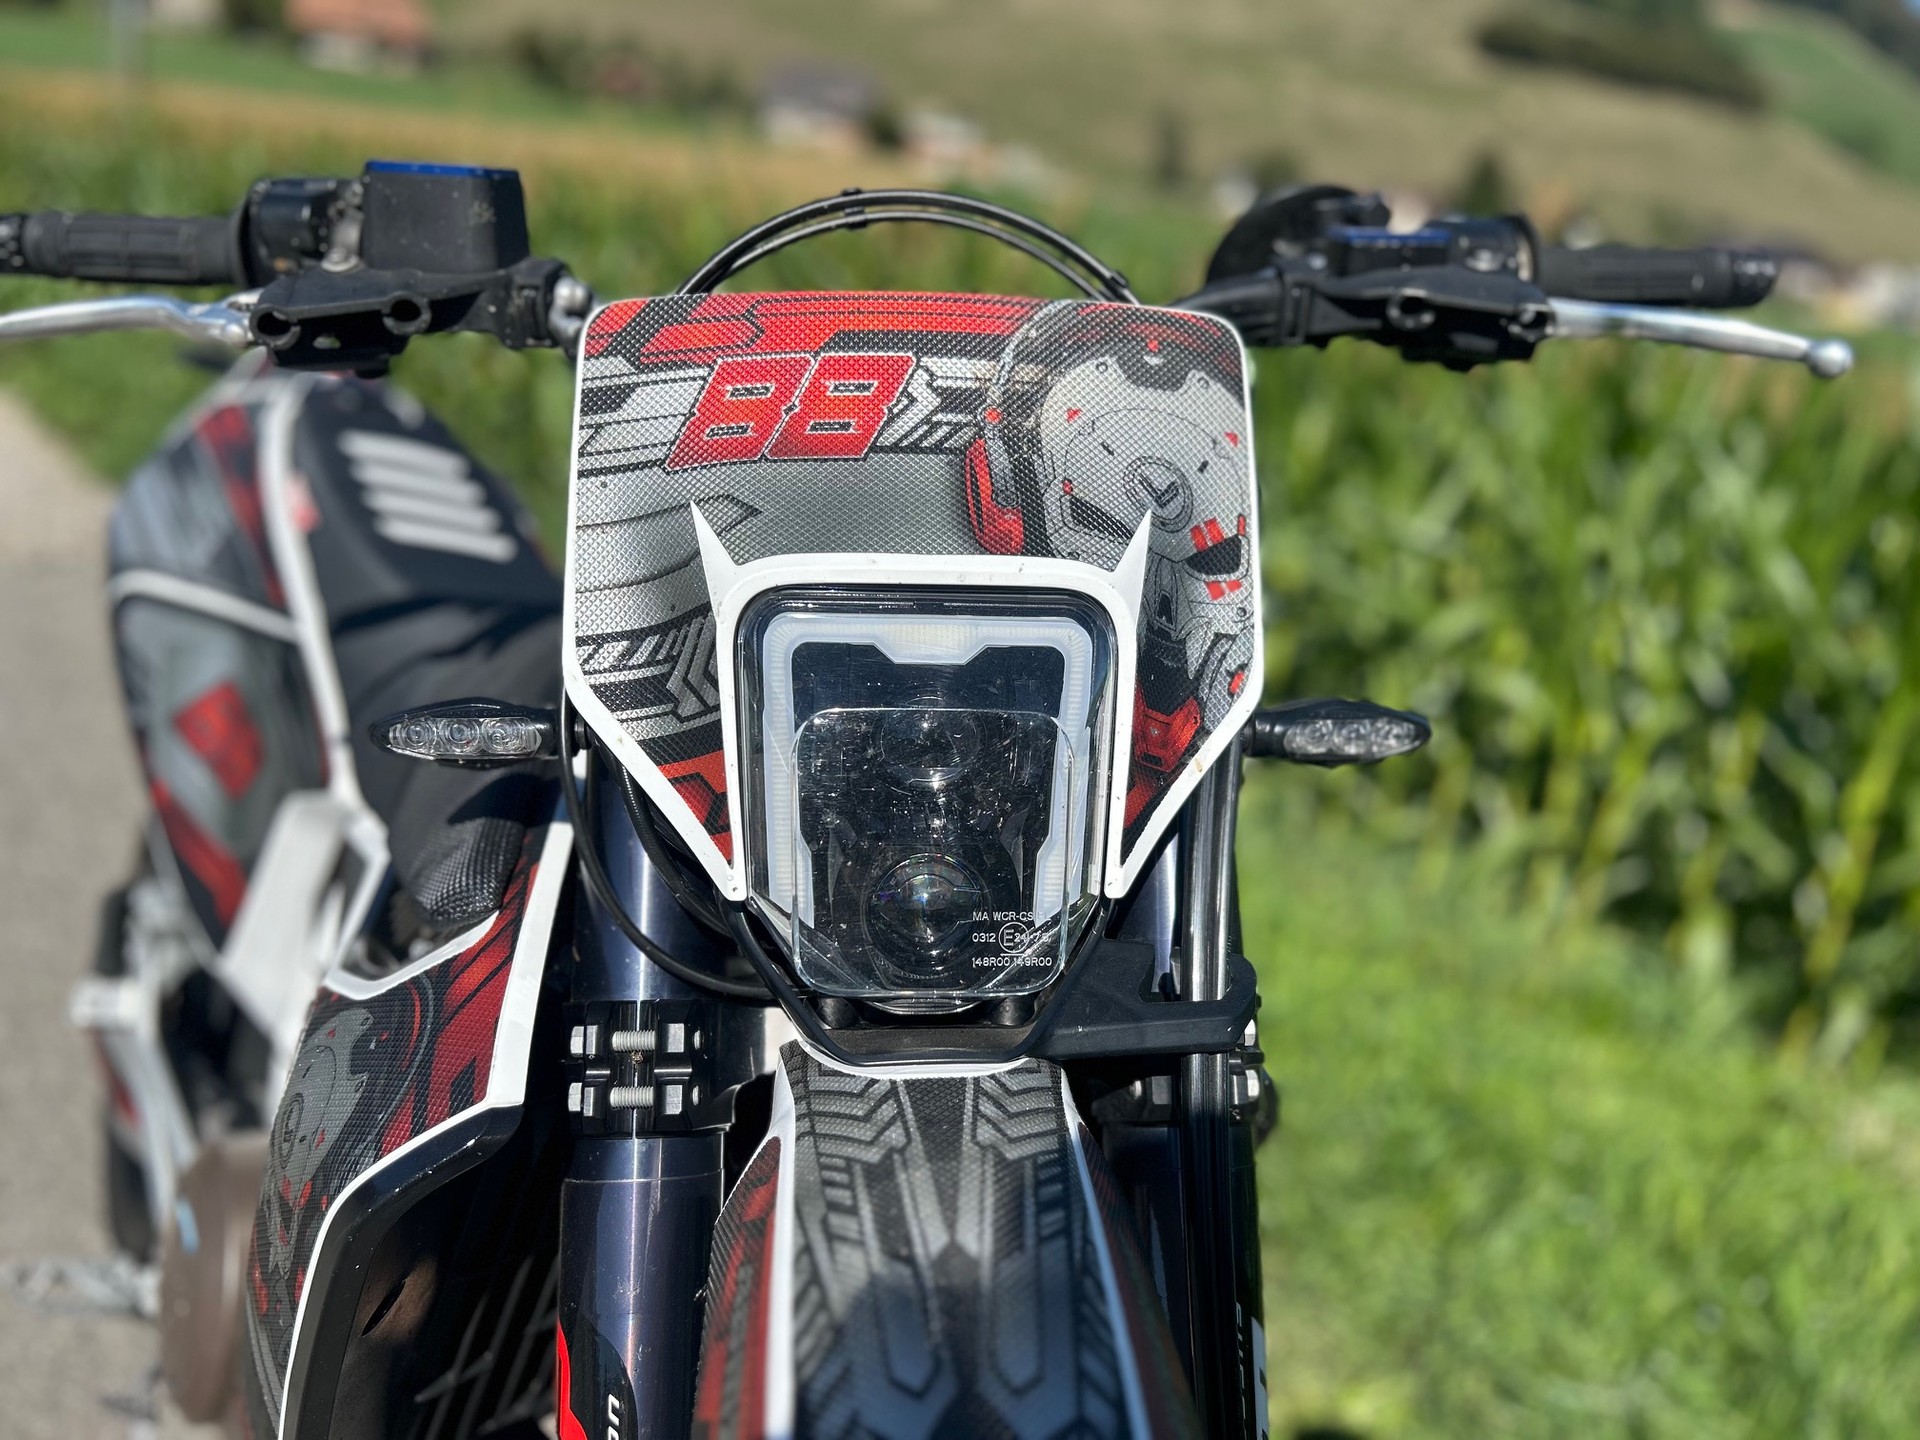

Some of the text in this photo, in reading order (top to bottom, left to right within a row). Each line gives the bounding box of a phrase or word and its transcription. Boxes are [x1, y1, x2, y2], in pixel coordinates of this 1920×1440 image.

[666, 351, 917, 472] 88
[972, 911, 989, 921] MA
[992, 911, 1034, 921] WCR-CS
[971, 932, 996, 943] 0312
[971, 956, 1053, 967] 148R00 149R00
